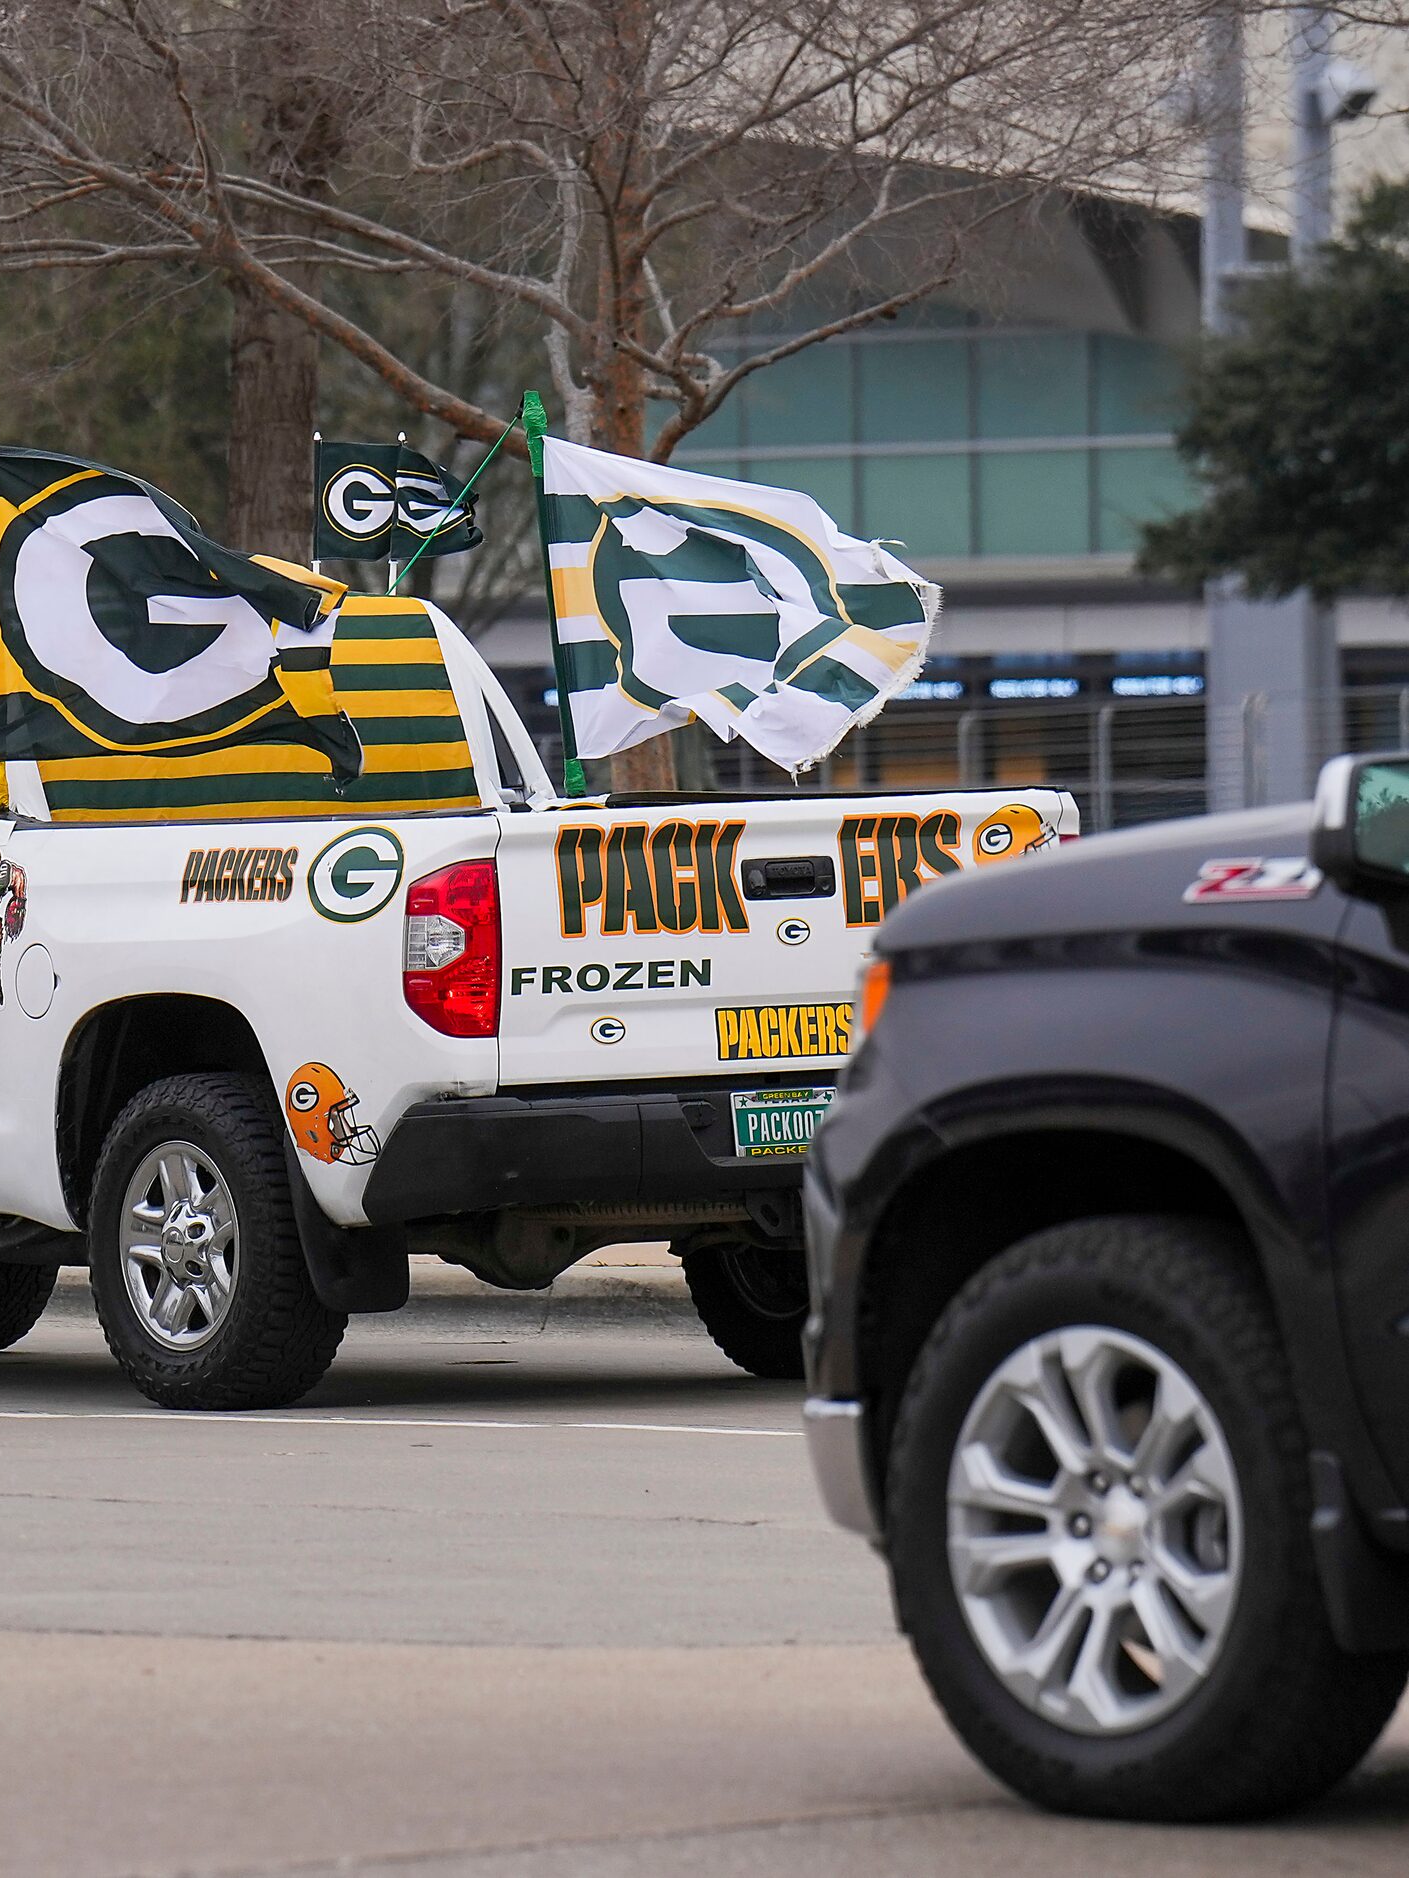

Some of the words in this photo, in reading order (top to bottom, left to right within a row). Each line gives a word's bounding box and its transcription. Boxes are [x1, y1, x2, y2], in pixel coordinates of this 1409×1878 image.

[328, 471, 395, 534] G
[13, 494, 279, 725] G
[980, 824, 1010, 855] G
[179, 844, 299, 905] PACKERS
[311, 830, 402, 919] G
[555, 818, 750, 939] PACK
[838, 808, 963, 929] ERS
[778, 919, 810, 945] G
[510, 958, 713, 997] FROZEN
[592, 1018, 625, 1044] G
[718, 1003, 854, 1060] PACKERS
[289, 1082, 319, 1112] G
[751, 1145, 808, 1156] PACKE
